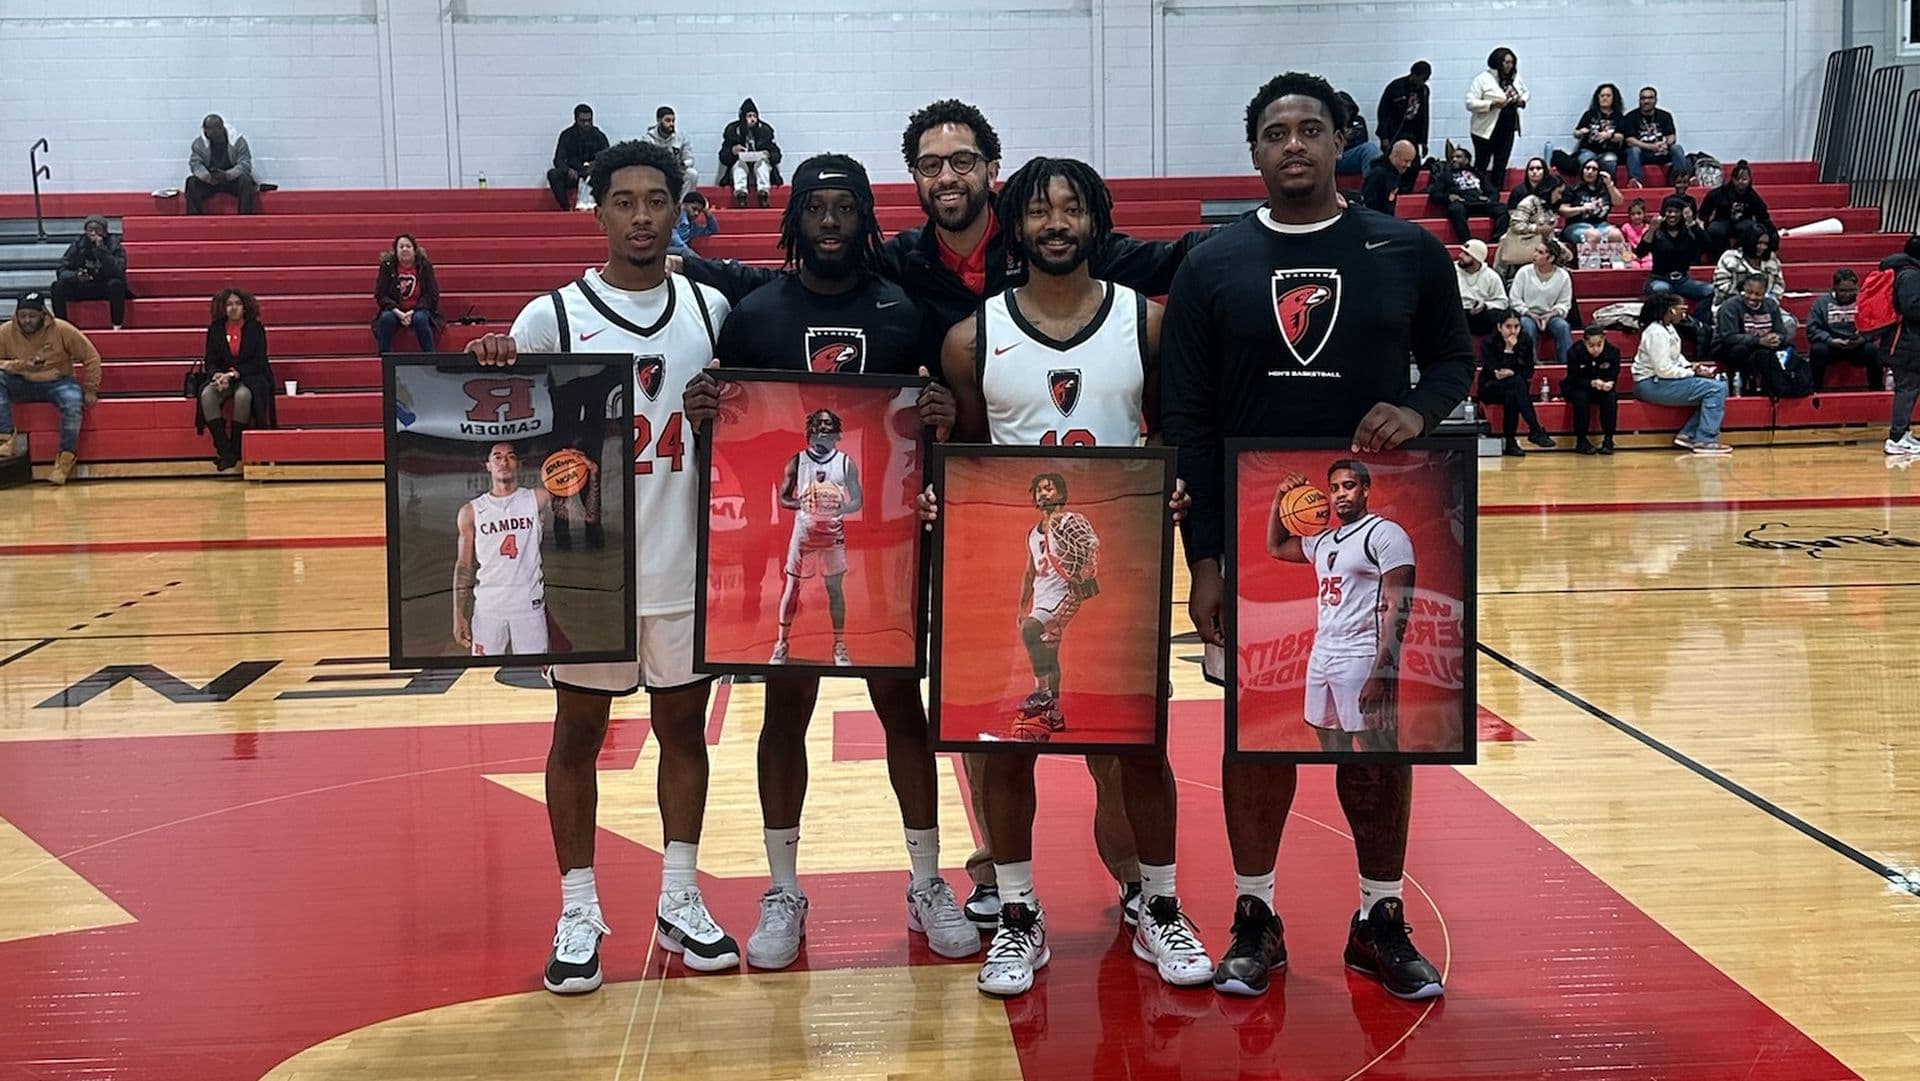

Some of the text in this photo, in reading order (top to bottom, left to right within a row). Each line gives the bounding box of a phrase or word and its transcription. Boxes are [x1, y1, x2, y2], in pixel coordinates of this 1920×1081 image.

[633, 411, 684, 475] 24
[480, 517, 534, 535] CAMDEN
[500, 534, 518, 559] 4
[1320, 576, 1342, 606] 25
